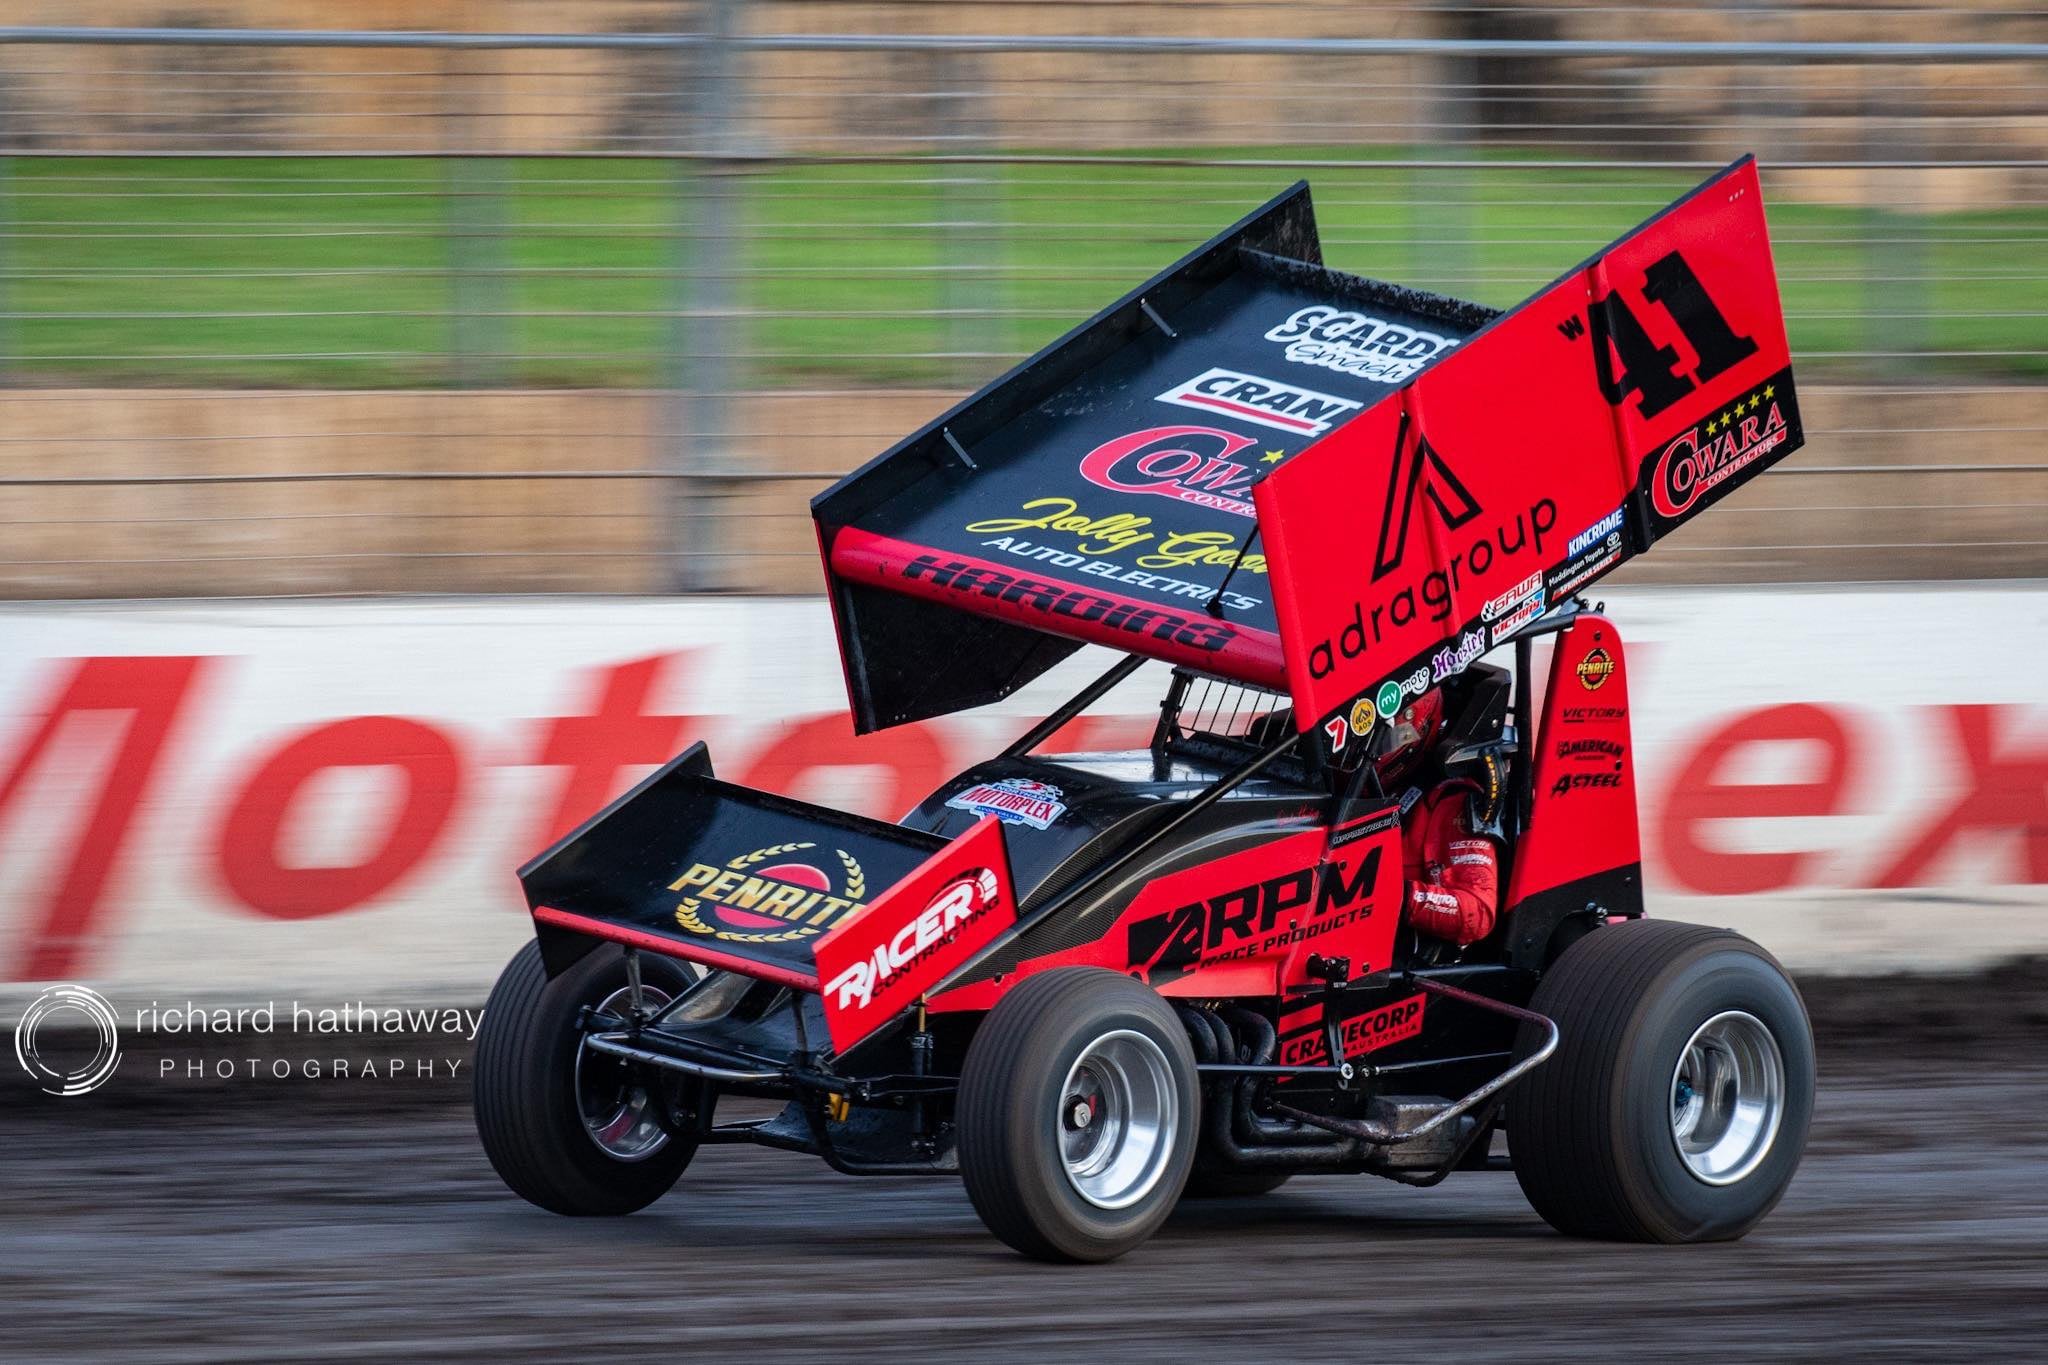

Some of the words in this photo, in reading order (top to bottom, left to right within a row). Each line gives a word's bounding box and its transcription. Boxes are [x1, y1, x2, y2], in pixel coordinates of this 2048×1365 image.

[1270, 308, 1454, 361] SCARD
[1557, 314, 1585, 341] W
[1587, 250, 1760, 421] 41
[1652, 397, 1787, 518] COWARA
[1706, 434, 1779, 488] CONTRACTORS
[966, 497, 1155, 555] Jolly
[1179, 490, 1258, 517] CONTR
[1567, 508, 1622, 557] KINCROME
[1584, 546, 1605, 564] Toyota
[981, 536, 1086, 568] AUTO
[1079, 561, 1263, 610] ELECTRICS
[1309, 498, 1557, 680] adragroup
[902, 555, 1237, 652] HARDING
[1433, 627, 1485, 679] Hoosier
[1576, 661, 1615, 675] PENRITE
[1563, 708, 1626, 718] VICTORY
[960, 787, 1054, 821] MOTORPLEX
[824, 883, 974, 1010] RACER
[871, 895, 1000, 998] CONTRACTING
[1262, 904, 1374, 953] PRODUCTS
[1352, 1024, 1417, 1052] AUSTRALIA
